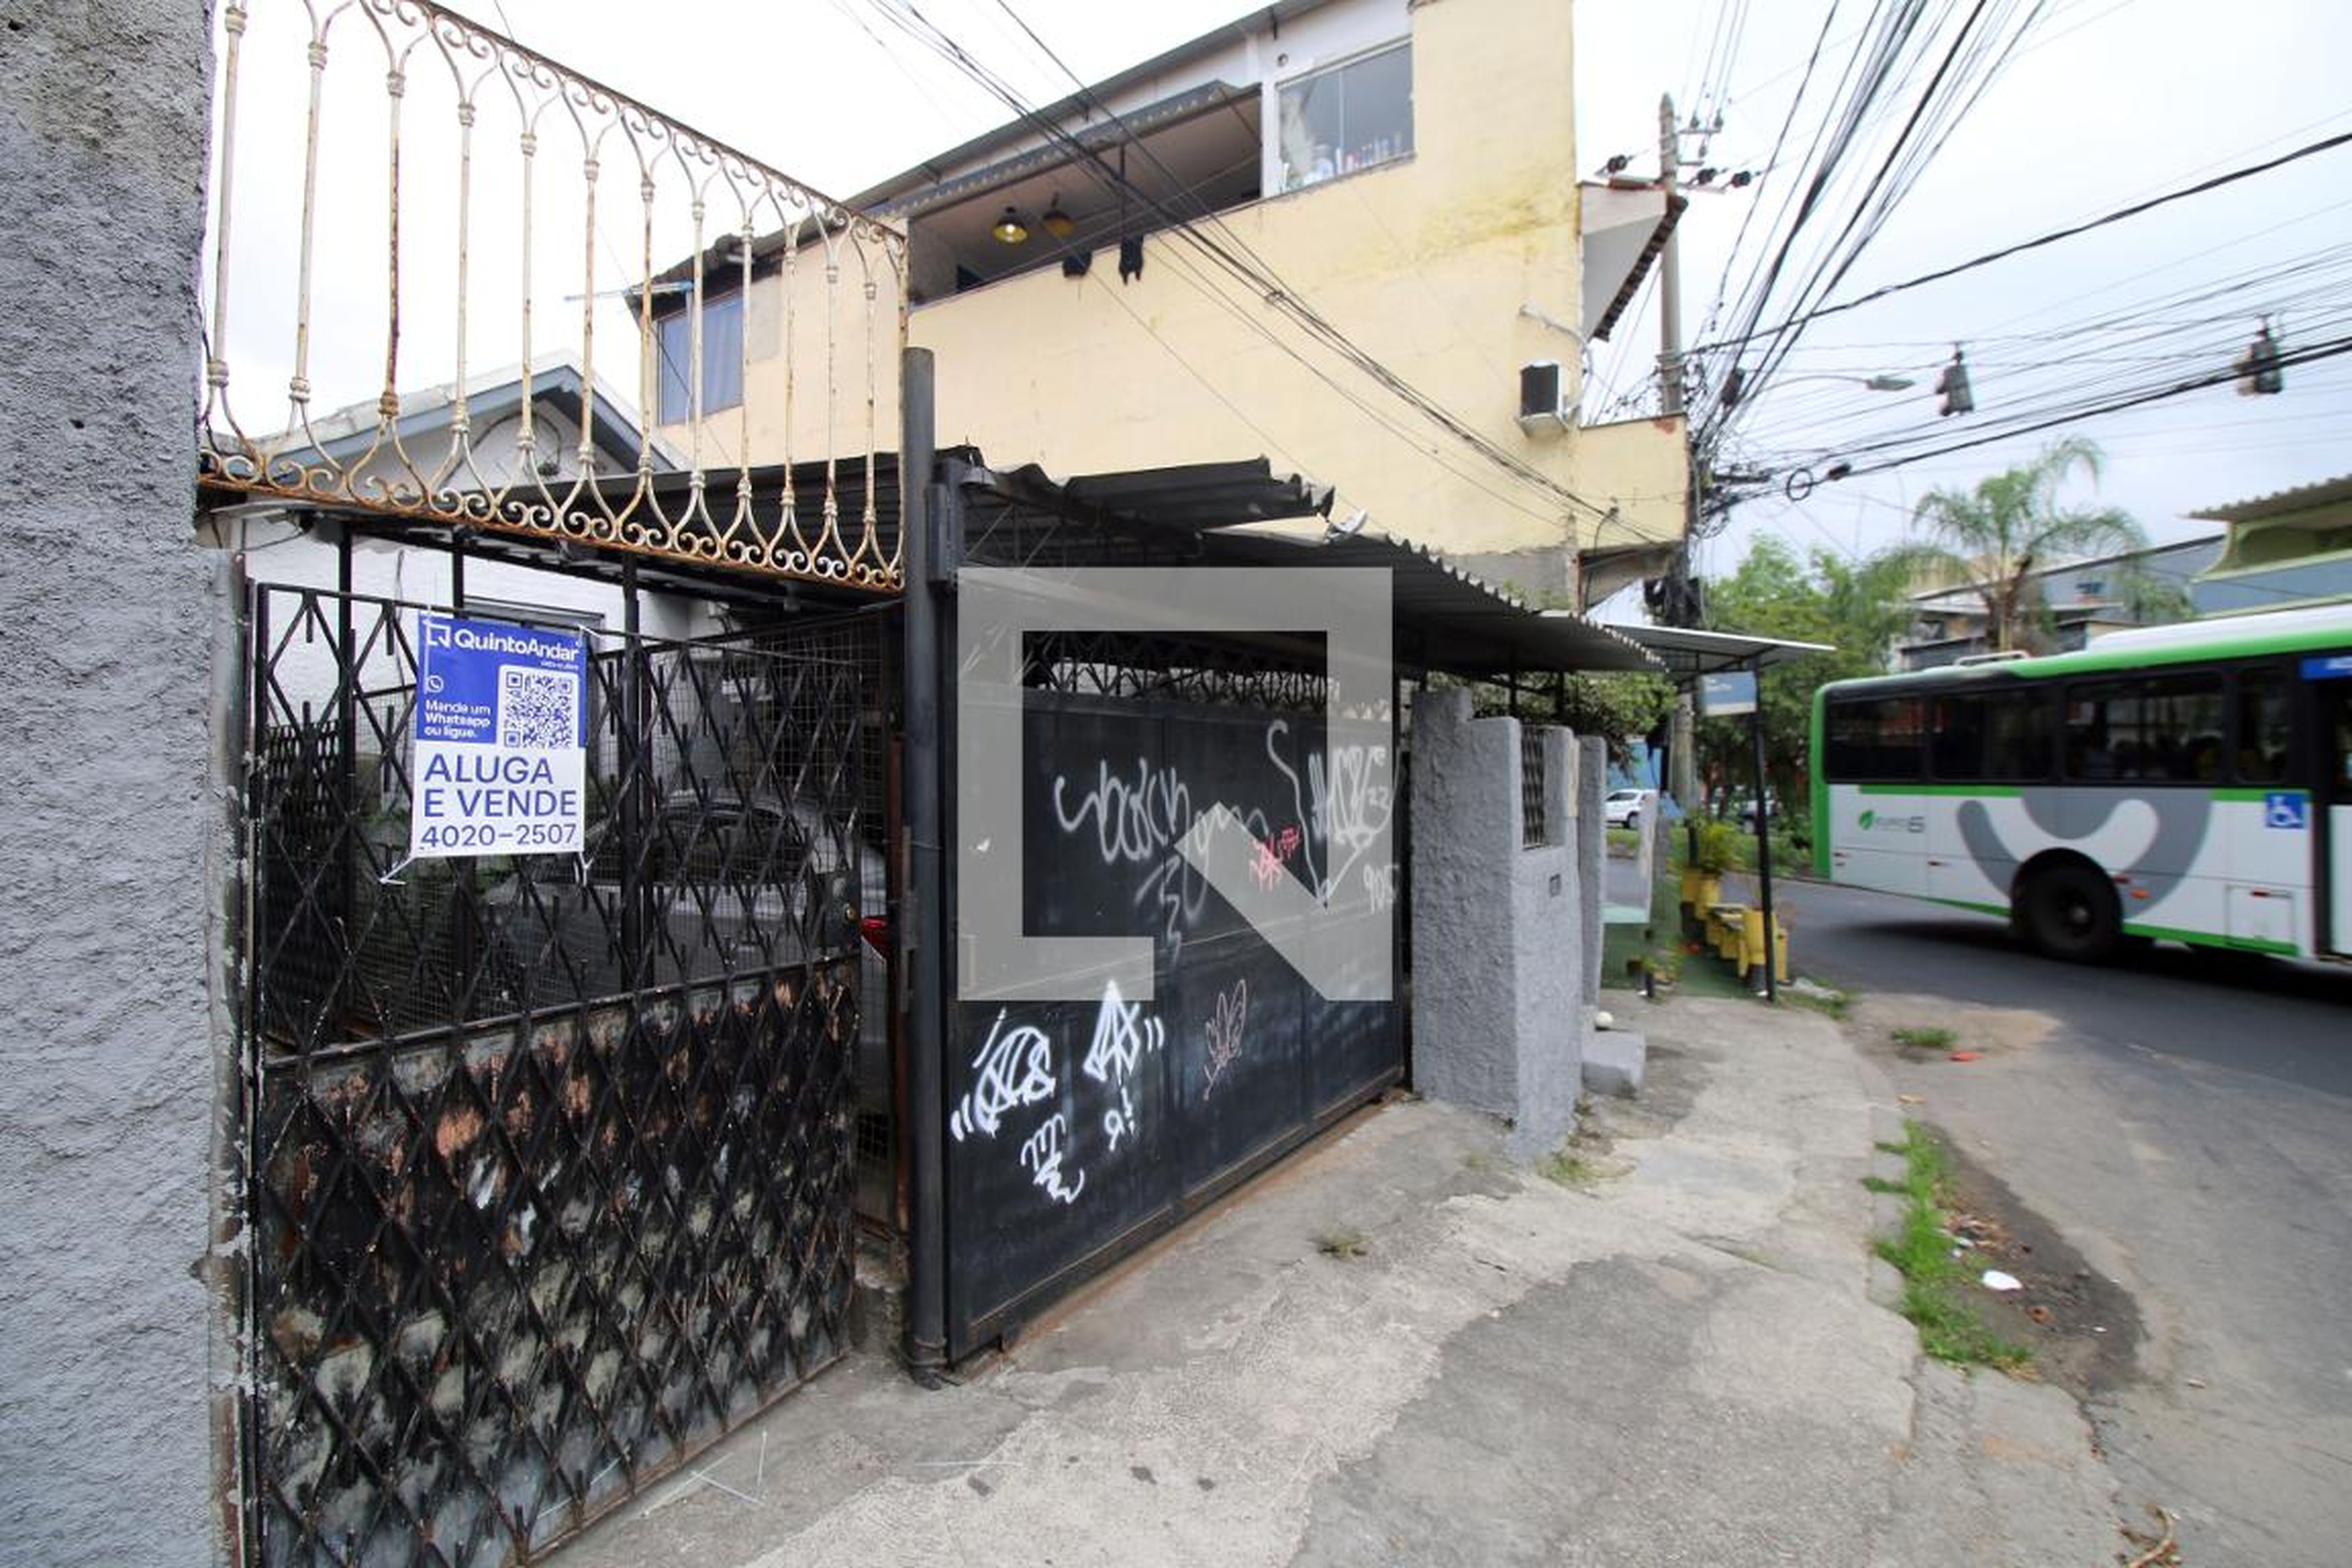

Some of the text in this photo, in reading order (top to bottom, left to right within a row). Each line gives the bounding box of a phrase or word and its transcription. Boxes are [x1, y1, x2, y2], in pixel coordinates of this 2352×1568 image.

[454, 628, 580, 662] QuintoAndar
[470, 706, 491, 715] um
[424, 726, 442, 736] ou
[424, 753, 553, 784] ALUGA
[424, 789, 576, 817] E VENDE
[421, 824, 576, 847] 4020-2507
